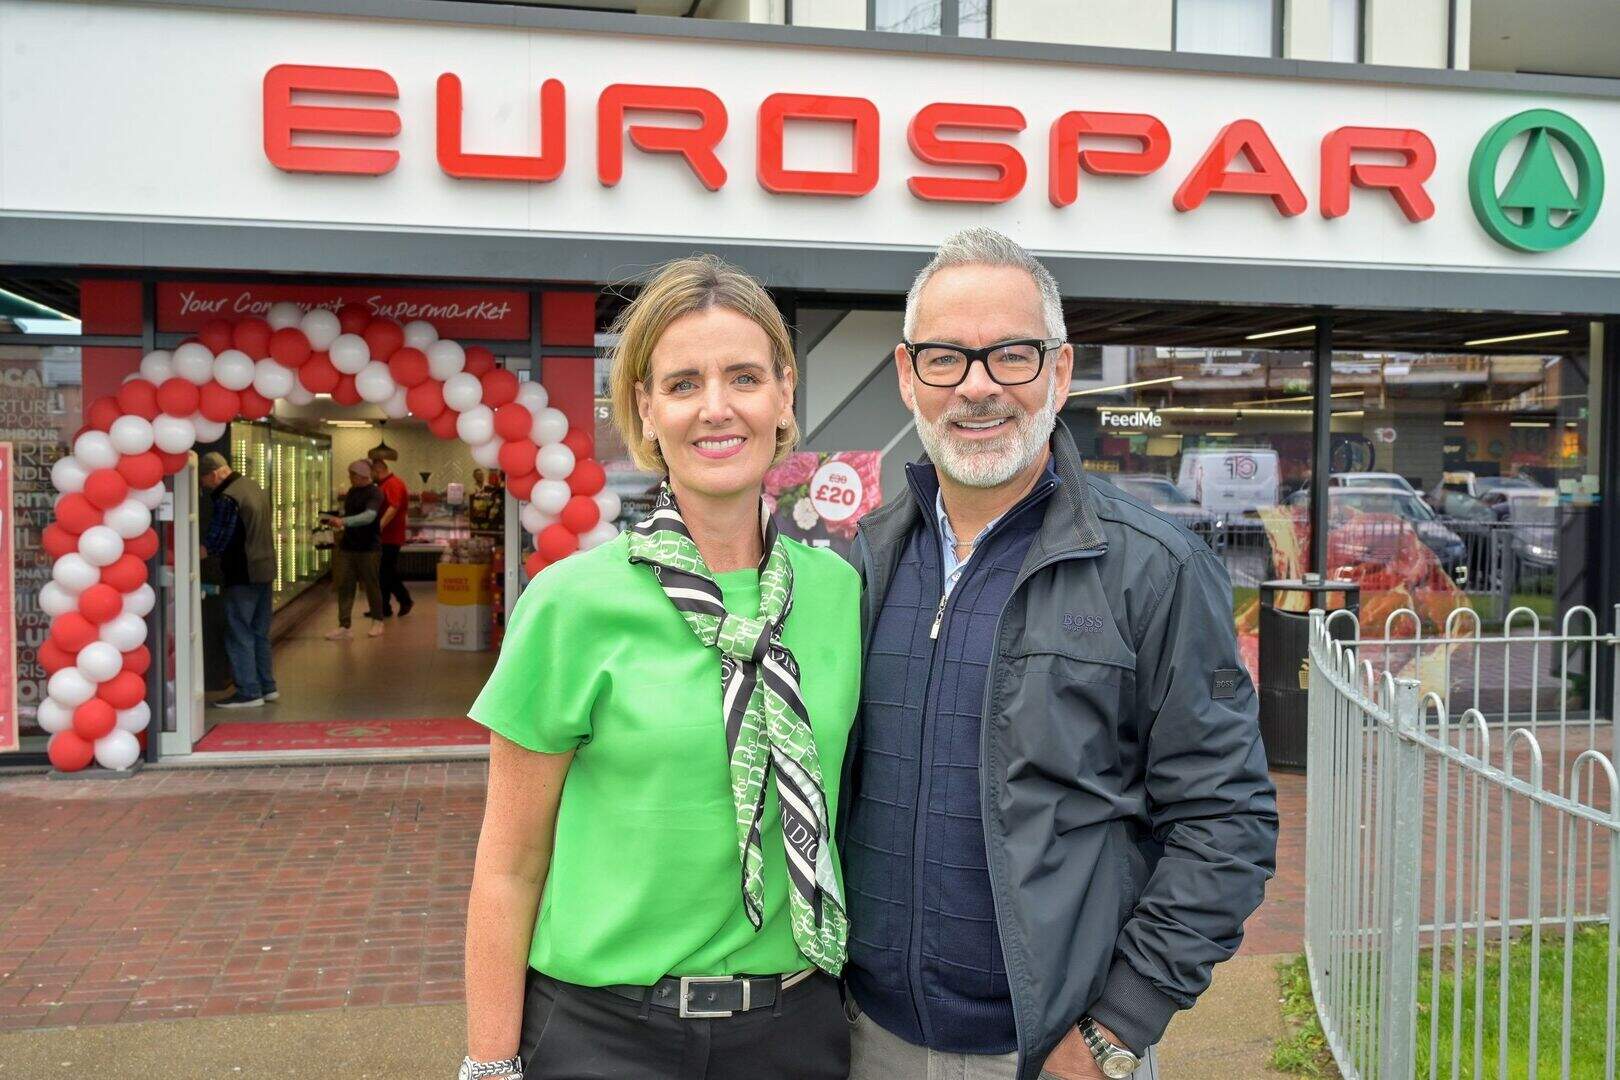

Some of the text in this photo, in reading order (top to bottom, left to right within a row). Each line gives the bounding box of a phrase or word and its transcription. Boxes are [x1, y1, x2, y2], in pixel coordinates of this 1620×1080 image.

[263, 63, 1437, 223] EUROSPAR
[179, 290, 229, 315] Your
[1101, 411, 1162, 427] FeedMe
[815, 484, 856, 506] £20
[1063, 613, 1103, 628] BOSS
